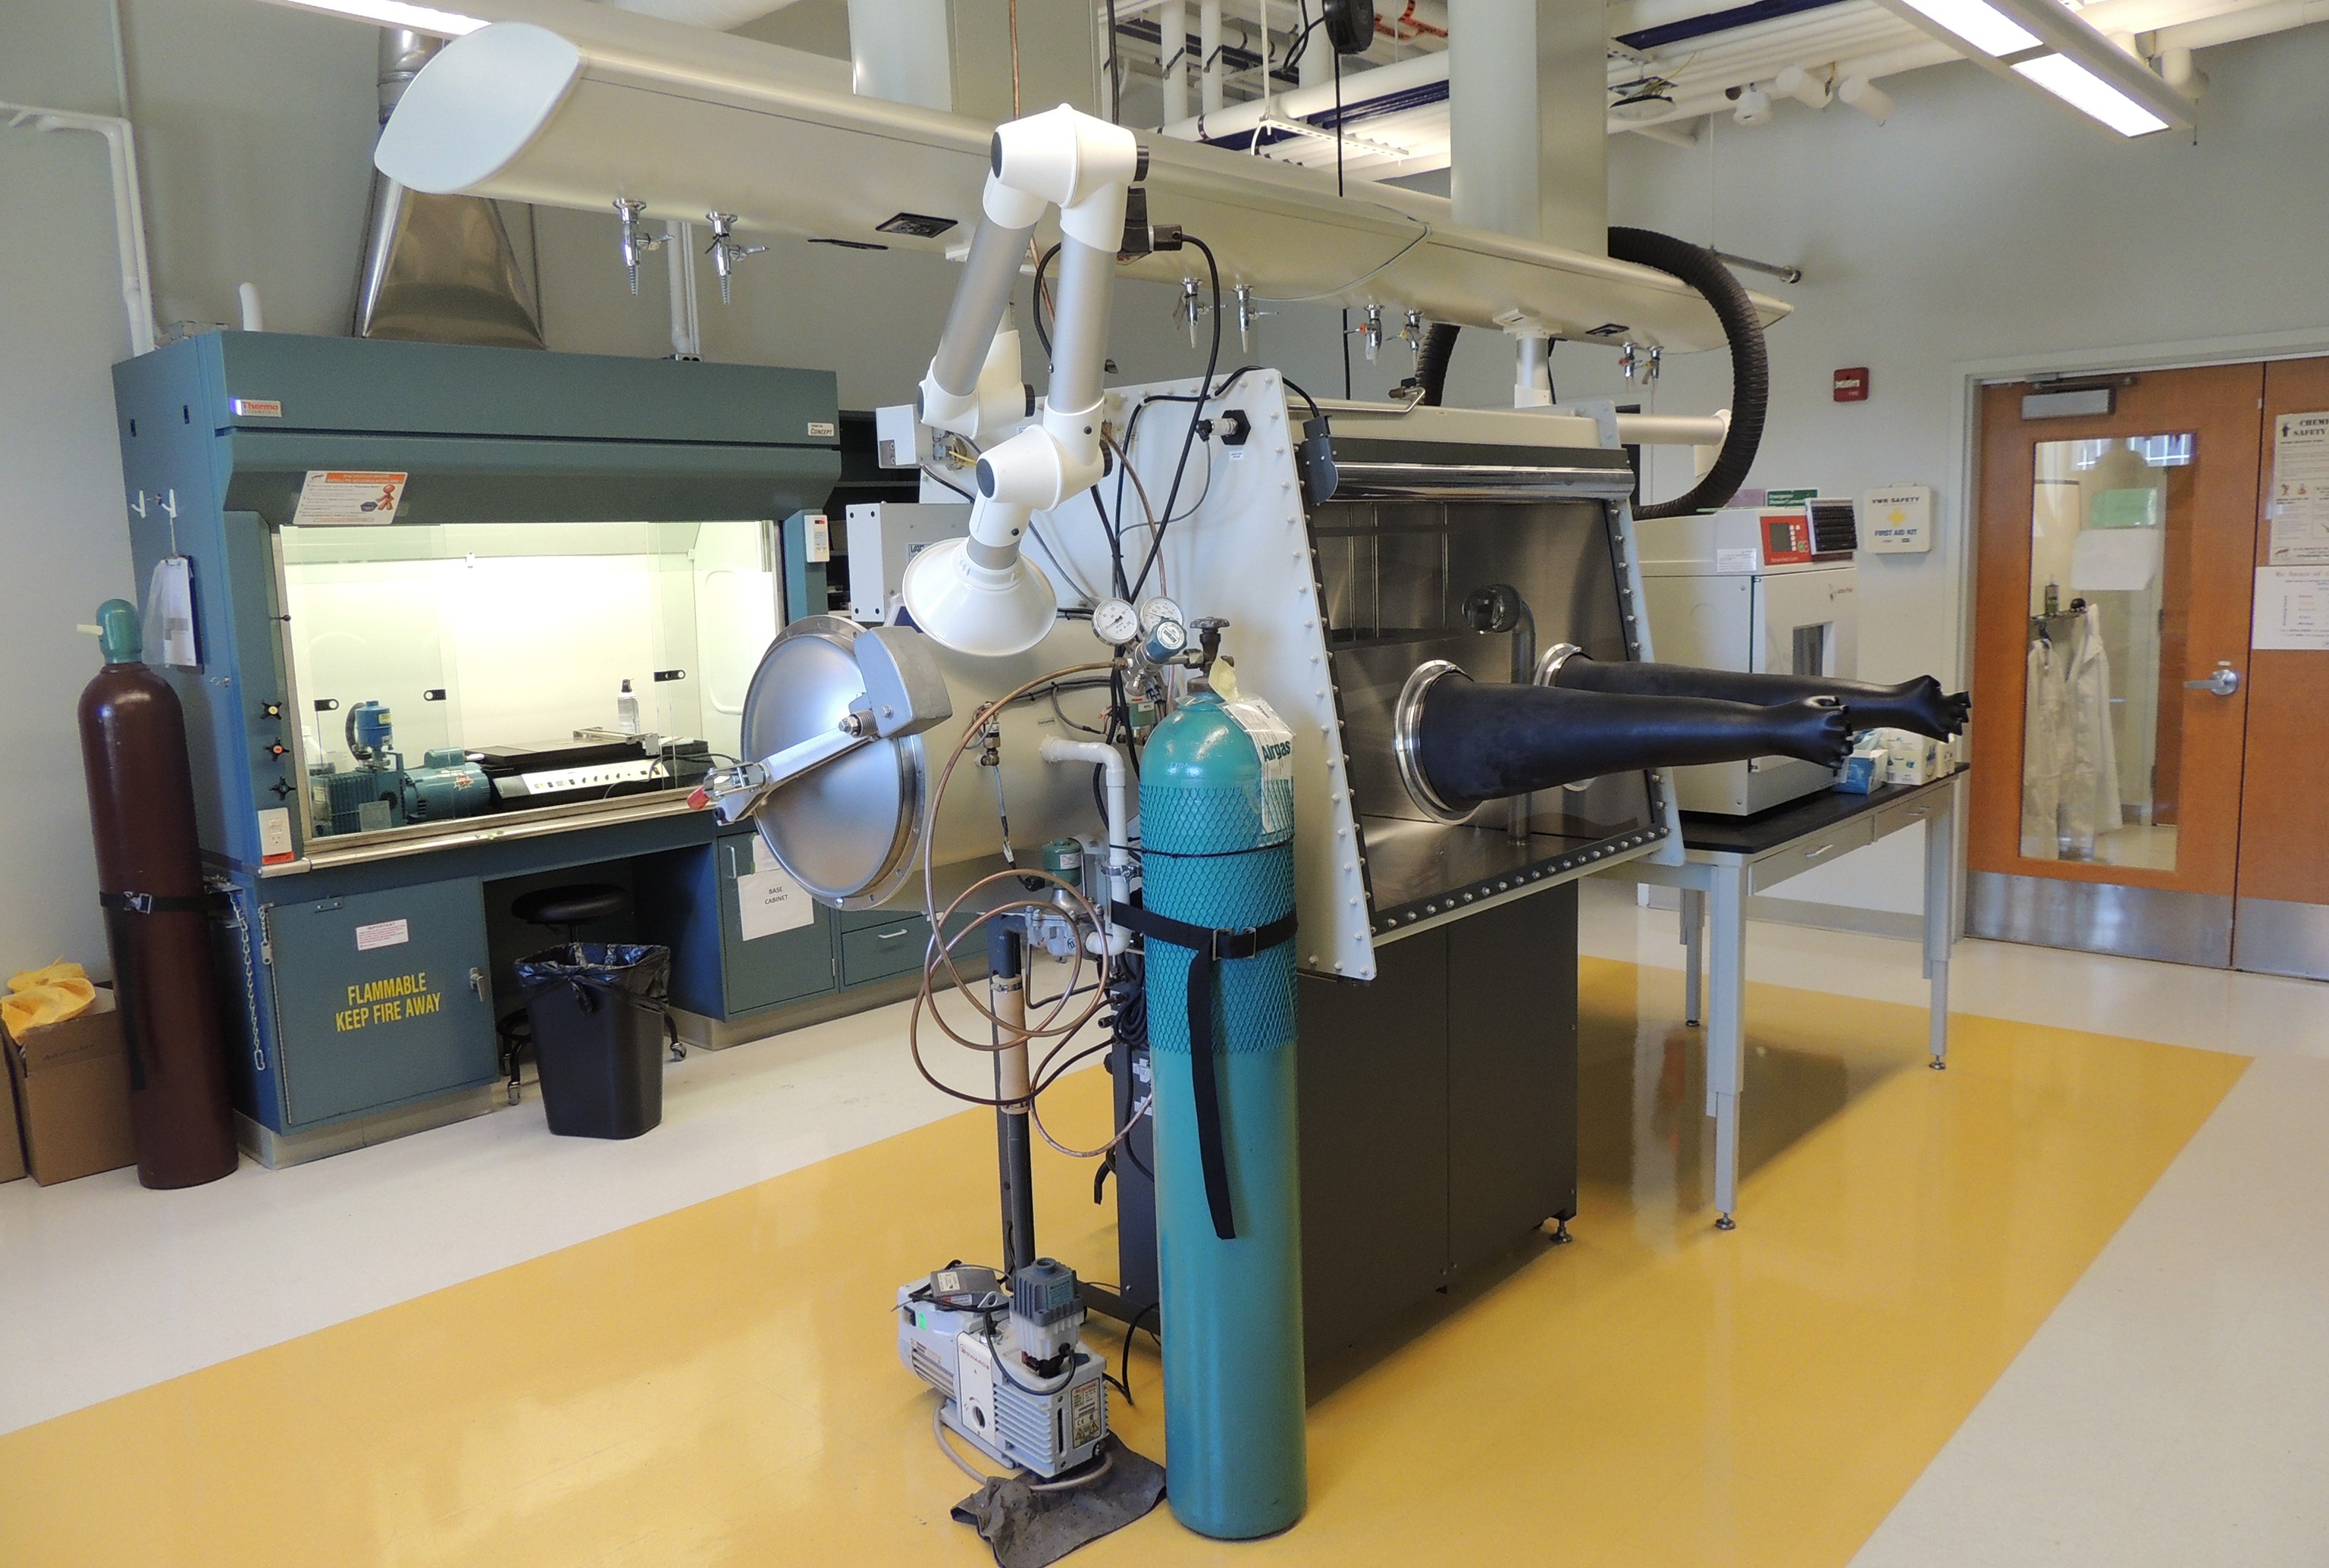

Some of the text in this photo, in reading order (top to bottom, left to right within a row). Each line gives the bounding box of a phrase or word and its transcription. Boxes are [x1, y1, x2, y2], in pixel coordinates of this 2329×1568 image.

[241, 400, 278, 410] Thermo
[1261, 740, 1291, 762] Airgas
[769, 886, 783, 895] BASE
[764, 894, 788, 905] CABINET
[347, 972, 427, 1006] FLAMMABLE
[335, 992, 441, 1032] KEEP FIRE AWAY
